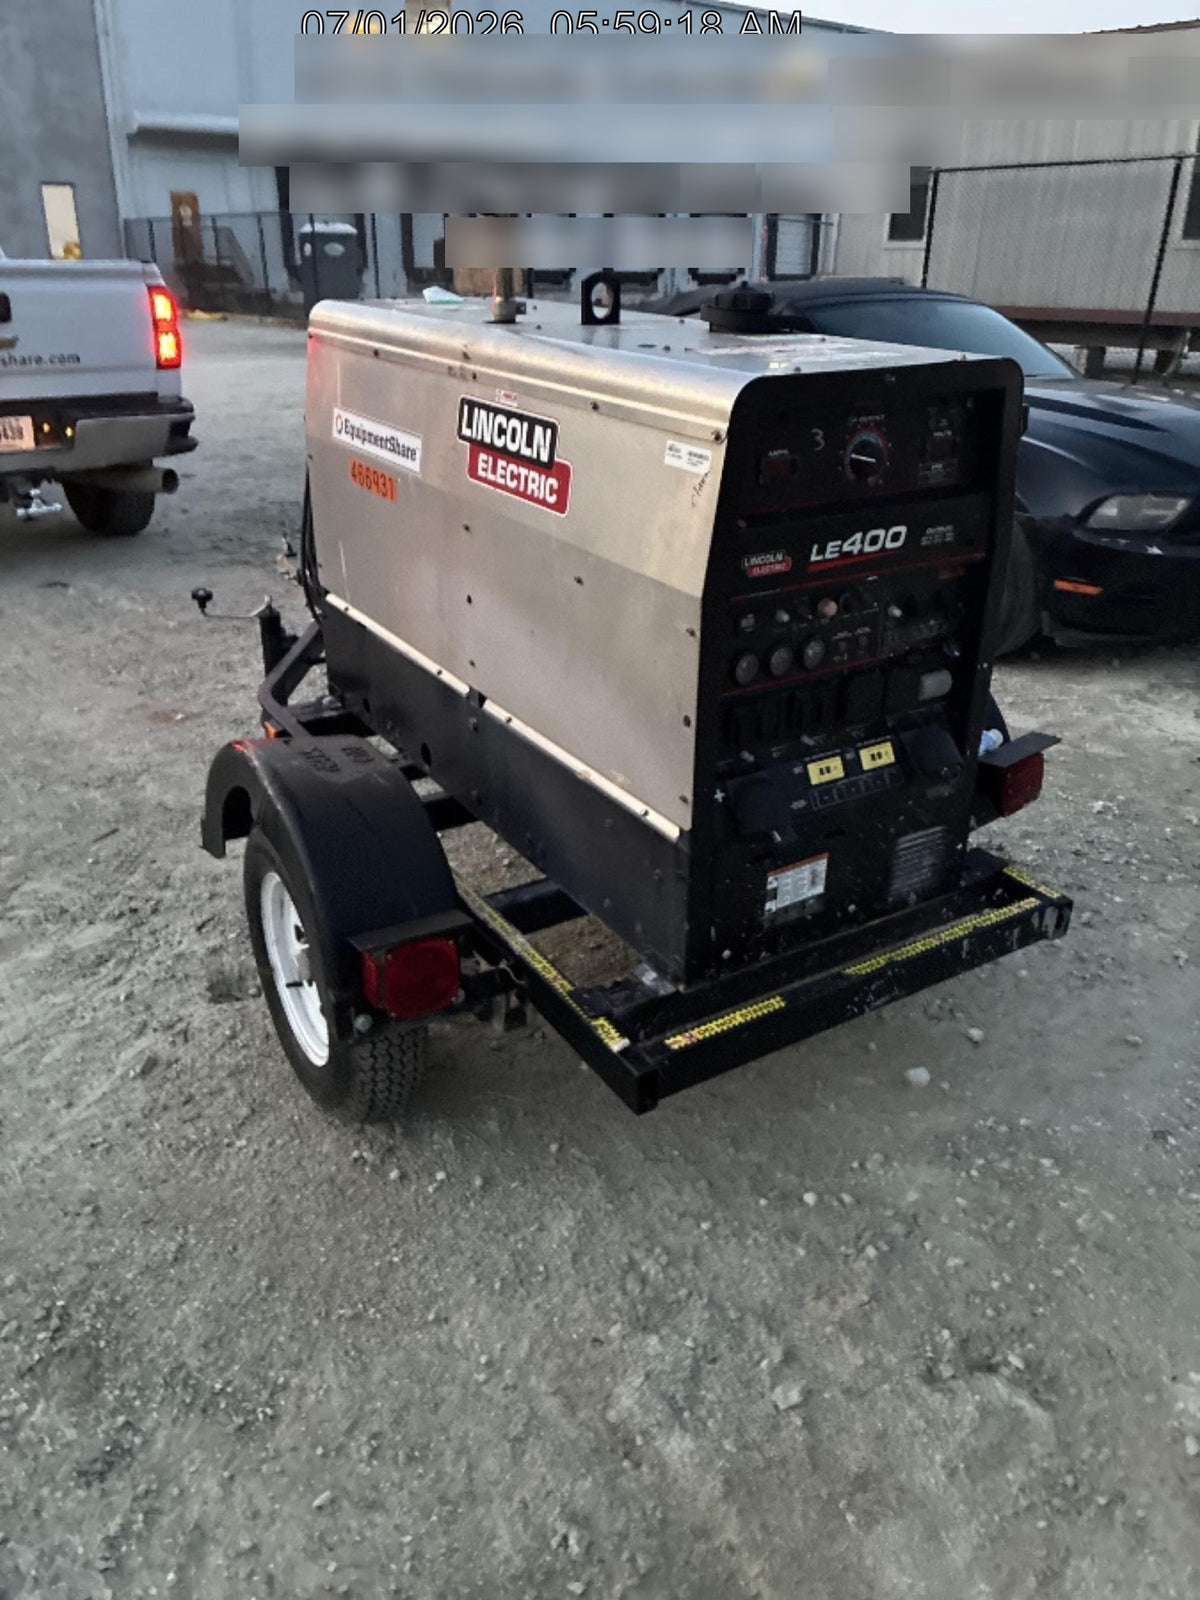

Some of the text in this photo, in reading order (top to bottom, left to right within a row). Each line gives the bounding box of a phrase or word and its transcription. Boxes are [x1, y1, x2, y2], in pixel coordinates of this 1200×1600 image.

[344, 418, 417, 462] EquipmentShare
[461, 403, 552, 464] LINCOLN
[477, 453, 559, 505] ELECTRIC
[810, 524, 908, 562] LE400
